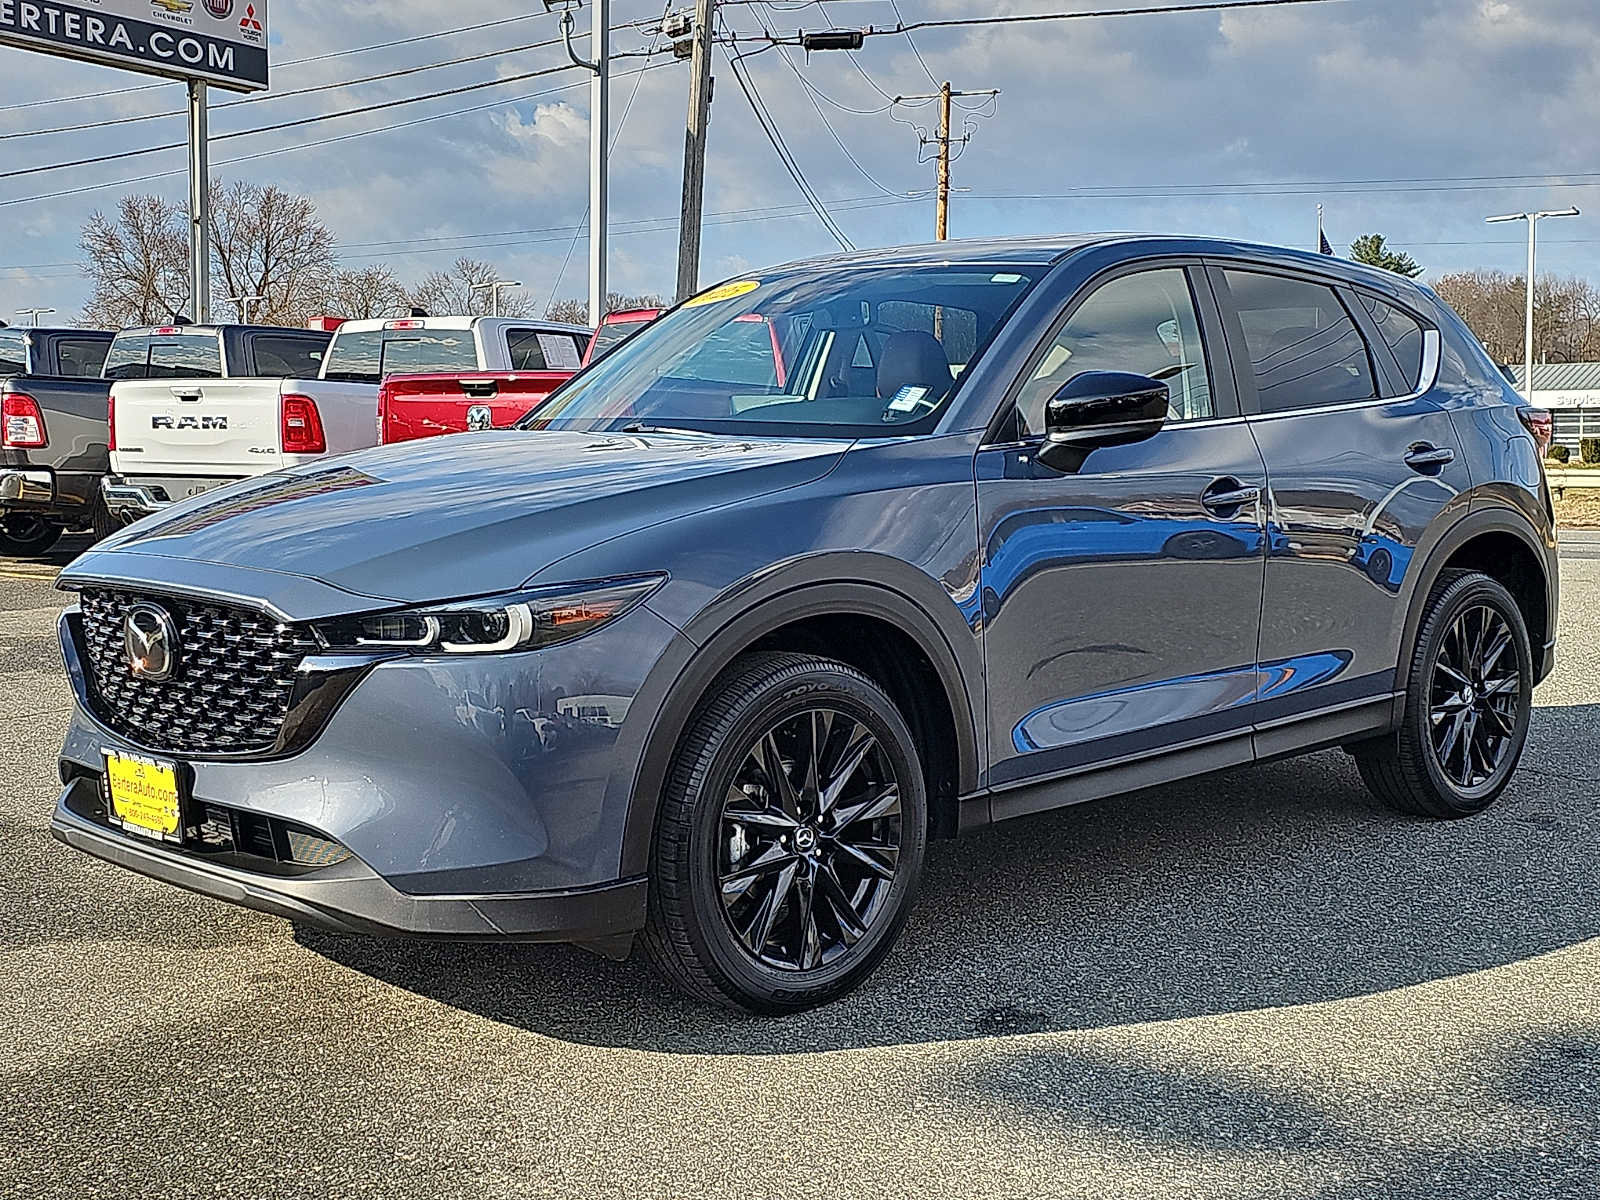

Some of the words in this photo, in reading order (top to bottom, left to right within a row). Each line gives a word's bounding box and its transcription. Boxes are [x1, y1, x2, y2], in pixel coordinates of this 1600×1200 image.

[152, 11, 193, 25] CHEVROLET
[0, 0, 235, 71] ERTERA.COM
[152, 416, 228, 430] RAM
